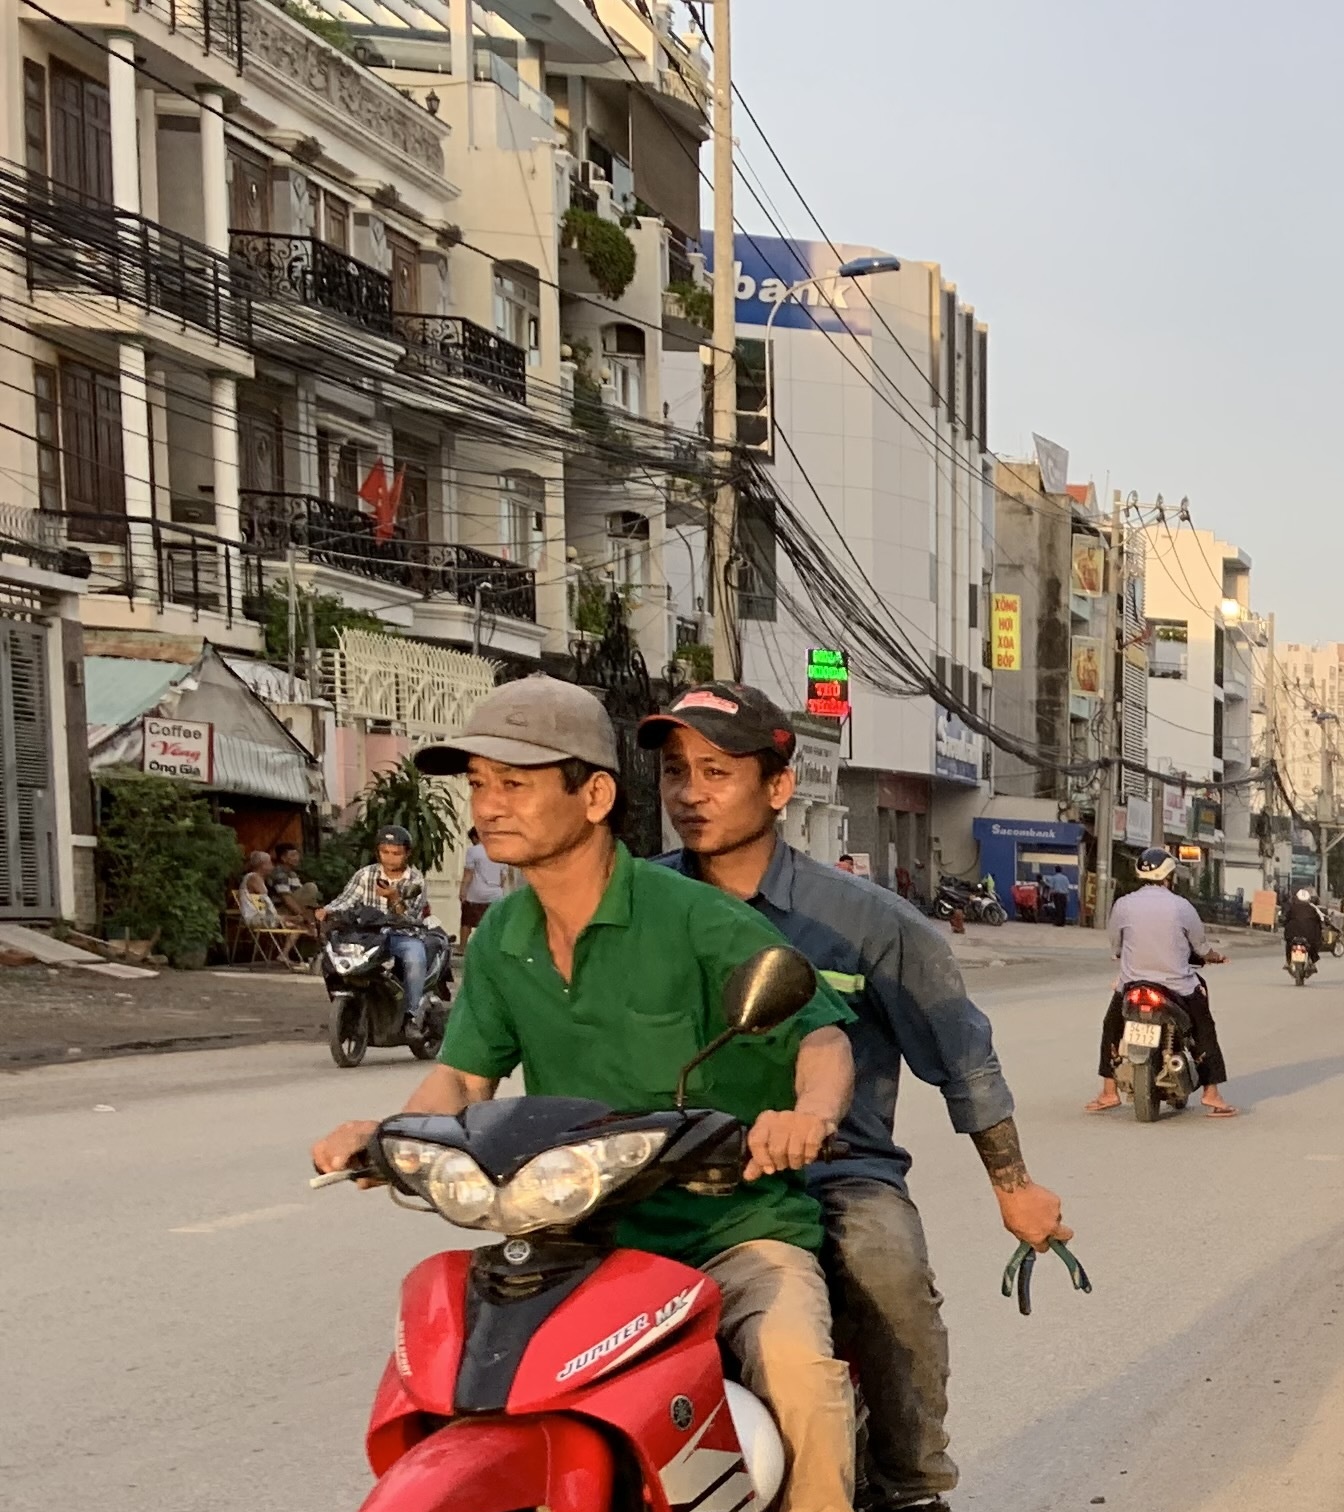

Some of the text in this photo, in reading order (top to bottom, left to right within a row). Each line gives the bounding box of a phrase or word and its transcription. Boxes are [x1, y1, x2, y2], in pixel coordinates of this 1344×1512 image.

[997, 635, 1015, 649] XOA
[148, 722, 202, 739] Coffee
[991, 824, 1056, 838] Sacombank
[557, 1286, 690, 1380] JUPITER MX
